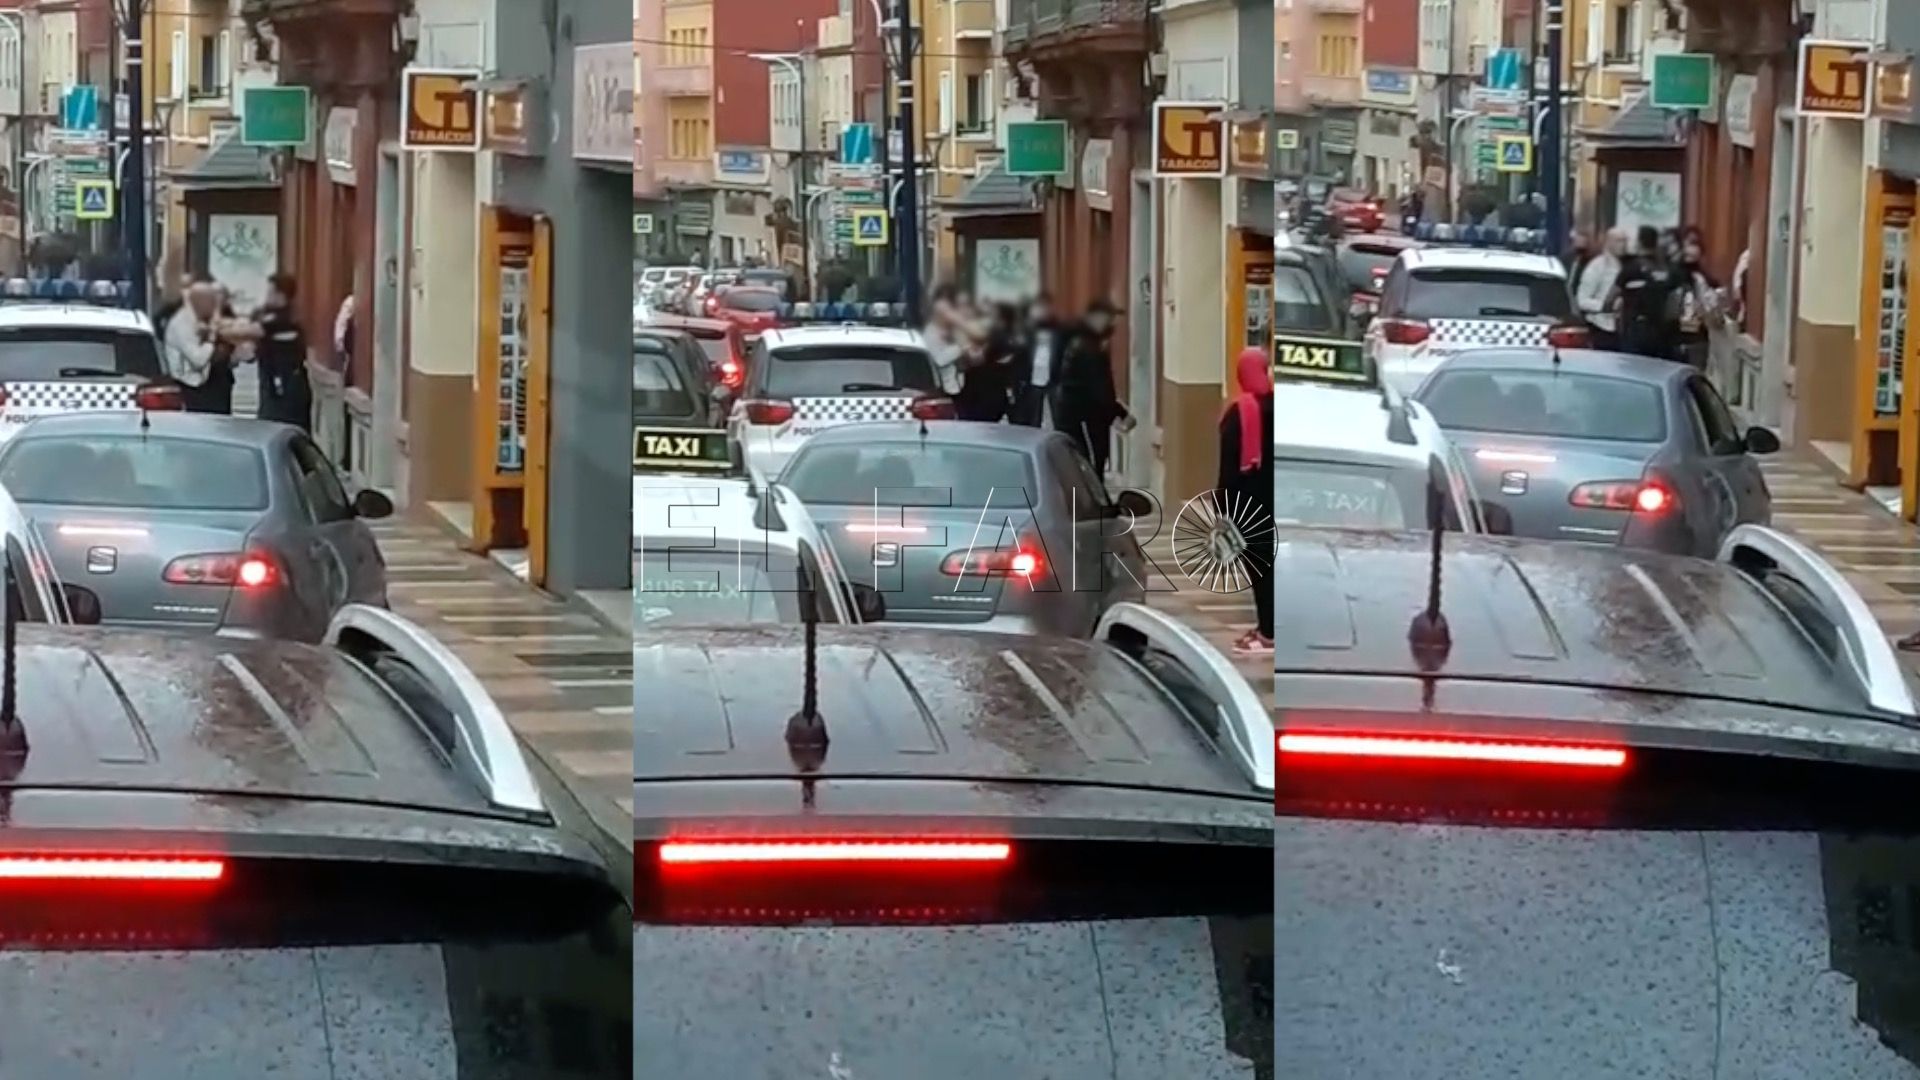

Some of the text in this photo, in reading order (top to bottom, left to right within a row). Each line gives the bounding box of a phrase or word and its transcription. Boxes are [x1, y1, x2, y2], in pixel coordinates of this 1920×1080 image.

[409, 129, 474, 143] TABACOS
[1161, 158, 1219, 170] TABACOS
[1279, 343, 1336, 368] TAXI
[643, 435, 700, 457] TAXI
[1322, 489, 1378, 514] TAXI
[693, 580, 748, 600] TAXI
